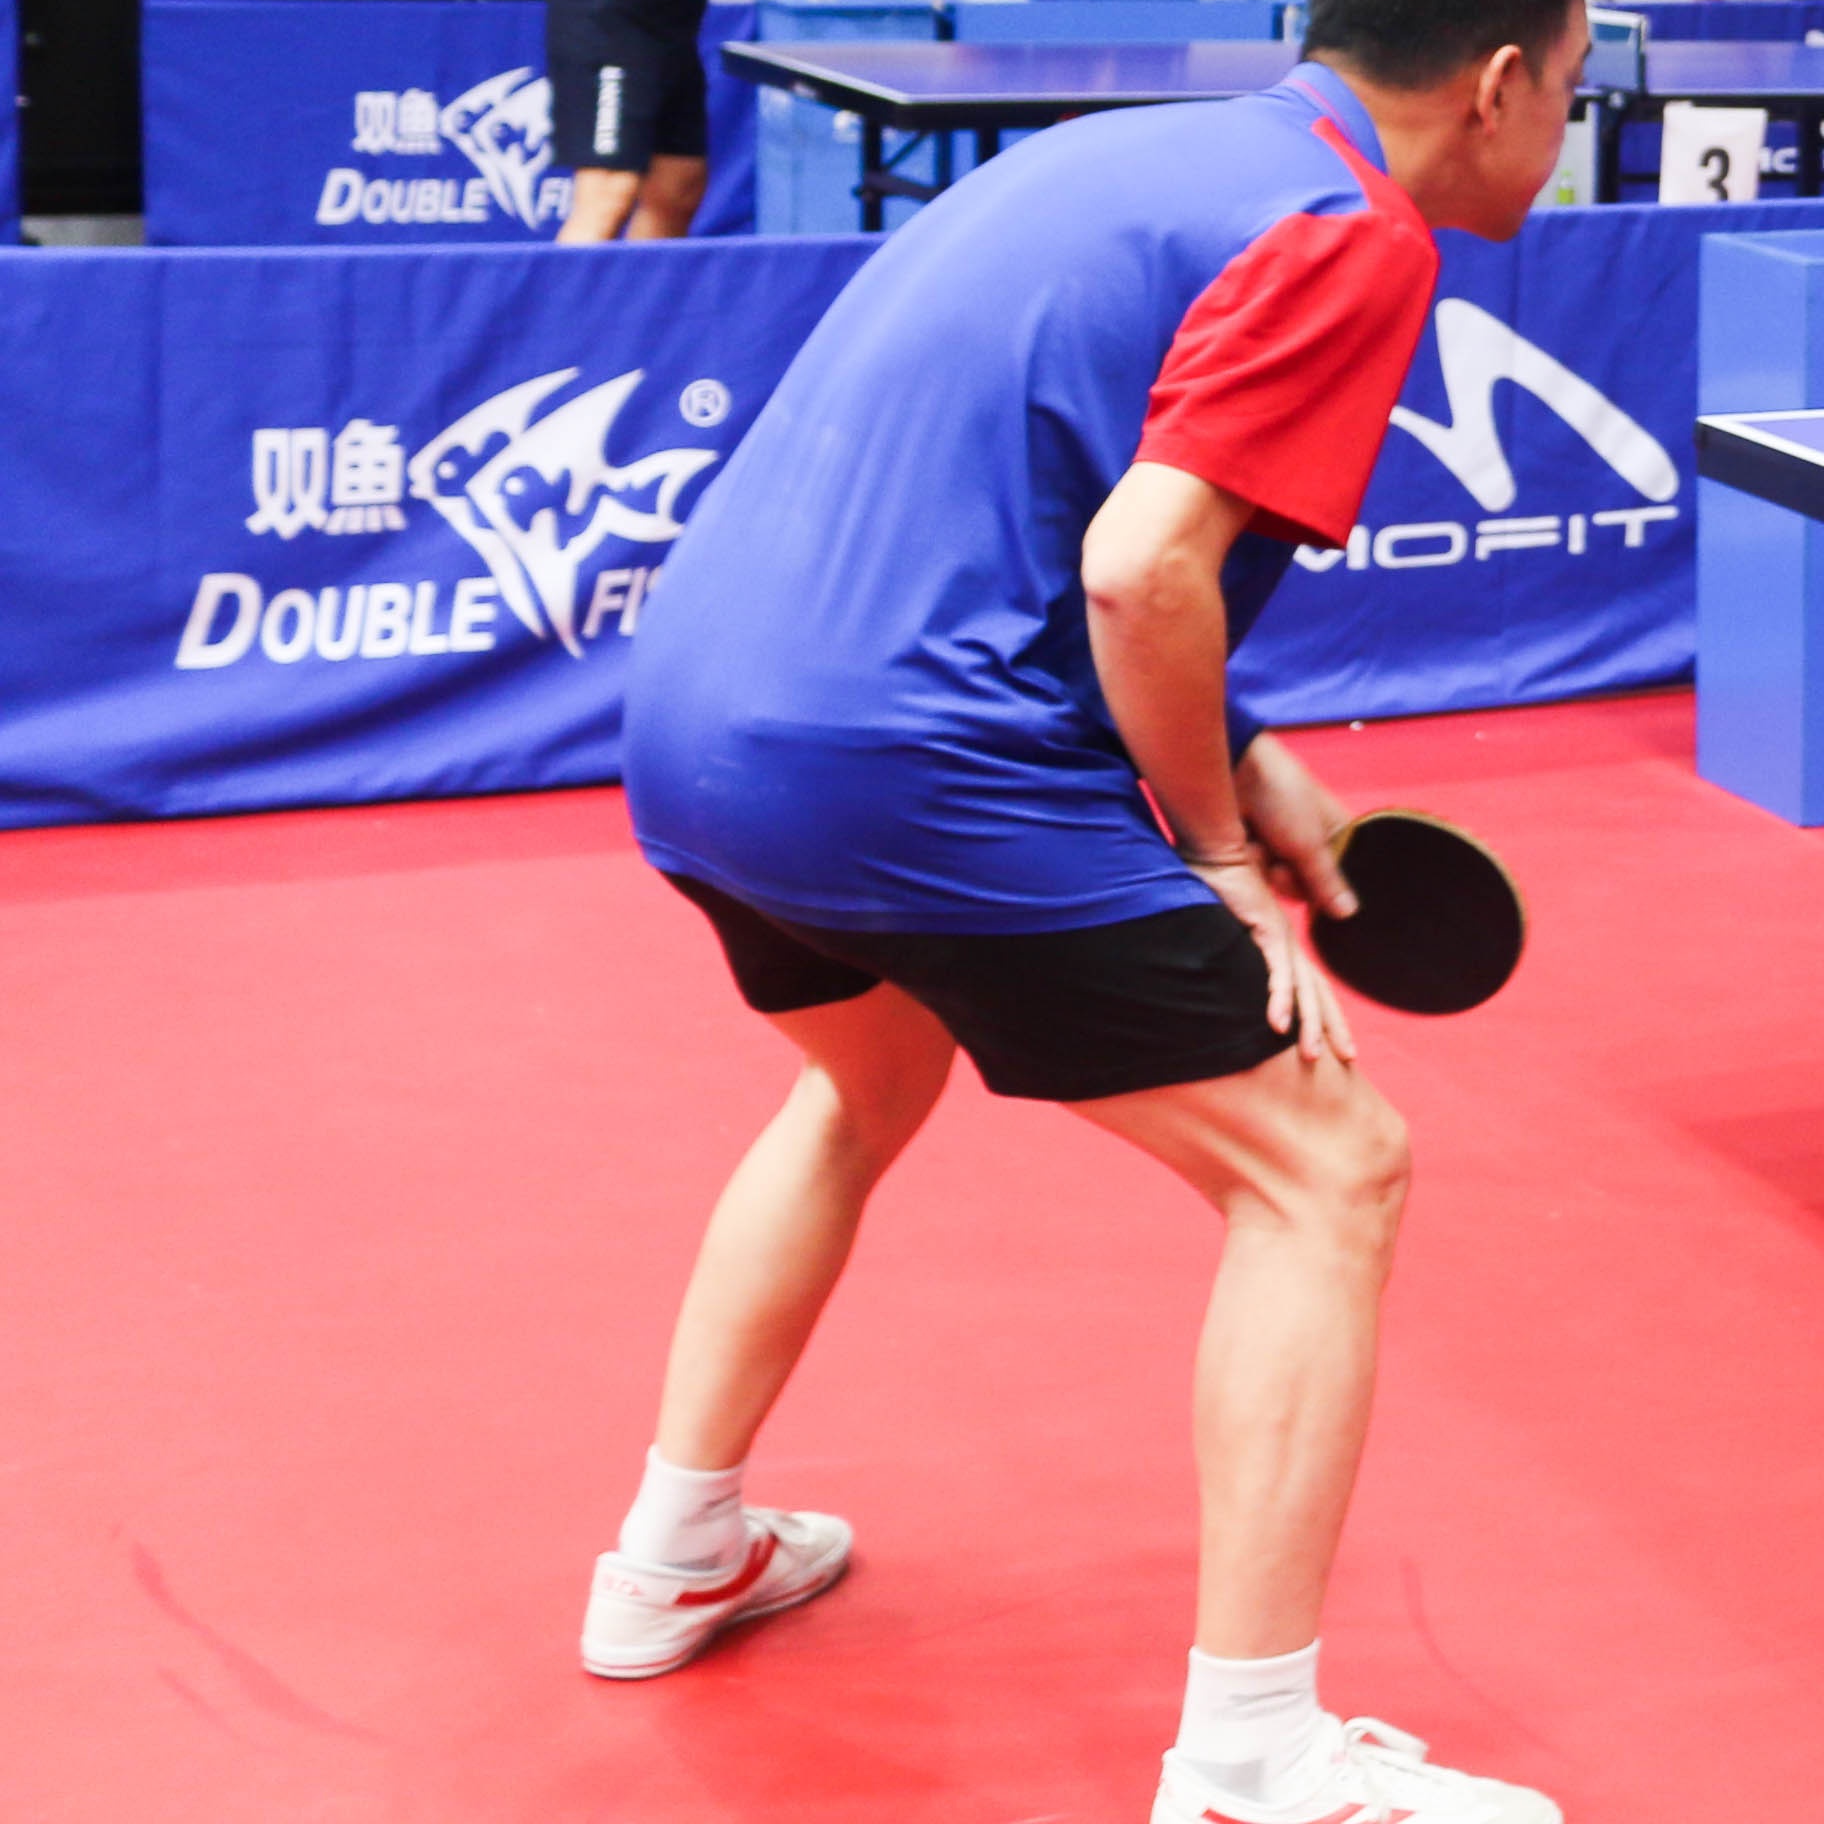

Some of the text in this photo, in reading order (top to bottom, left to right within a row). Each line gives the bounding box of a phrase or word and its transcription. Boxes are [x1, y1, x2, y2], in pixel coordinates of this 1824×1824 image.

[316, 167, 491, 225] DOUBLE
[1698, 147, 1730, 202] 3
[174, 572, 499, 670] DOUBLE
